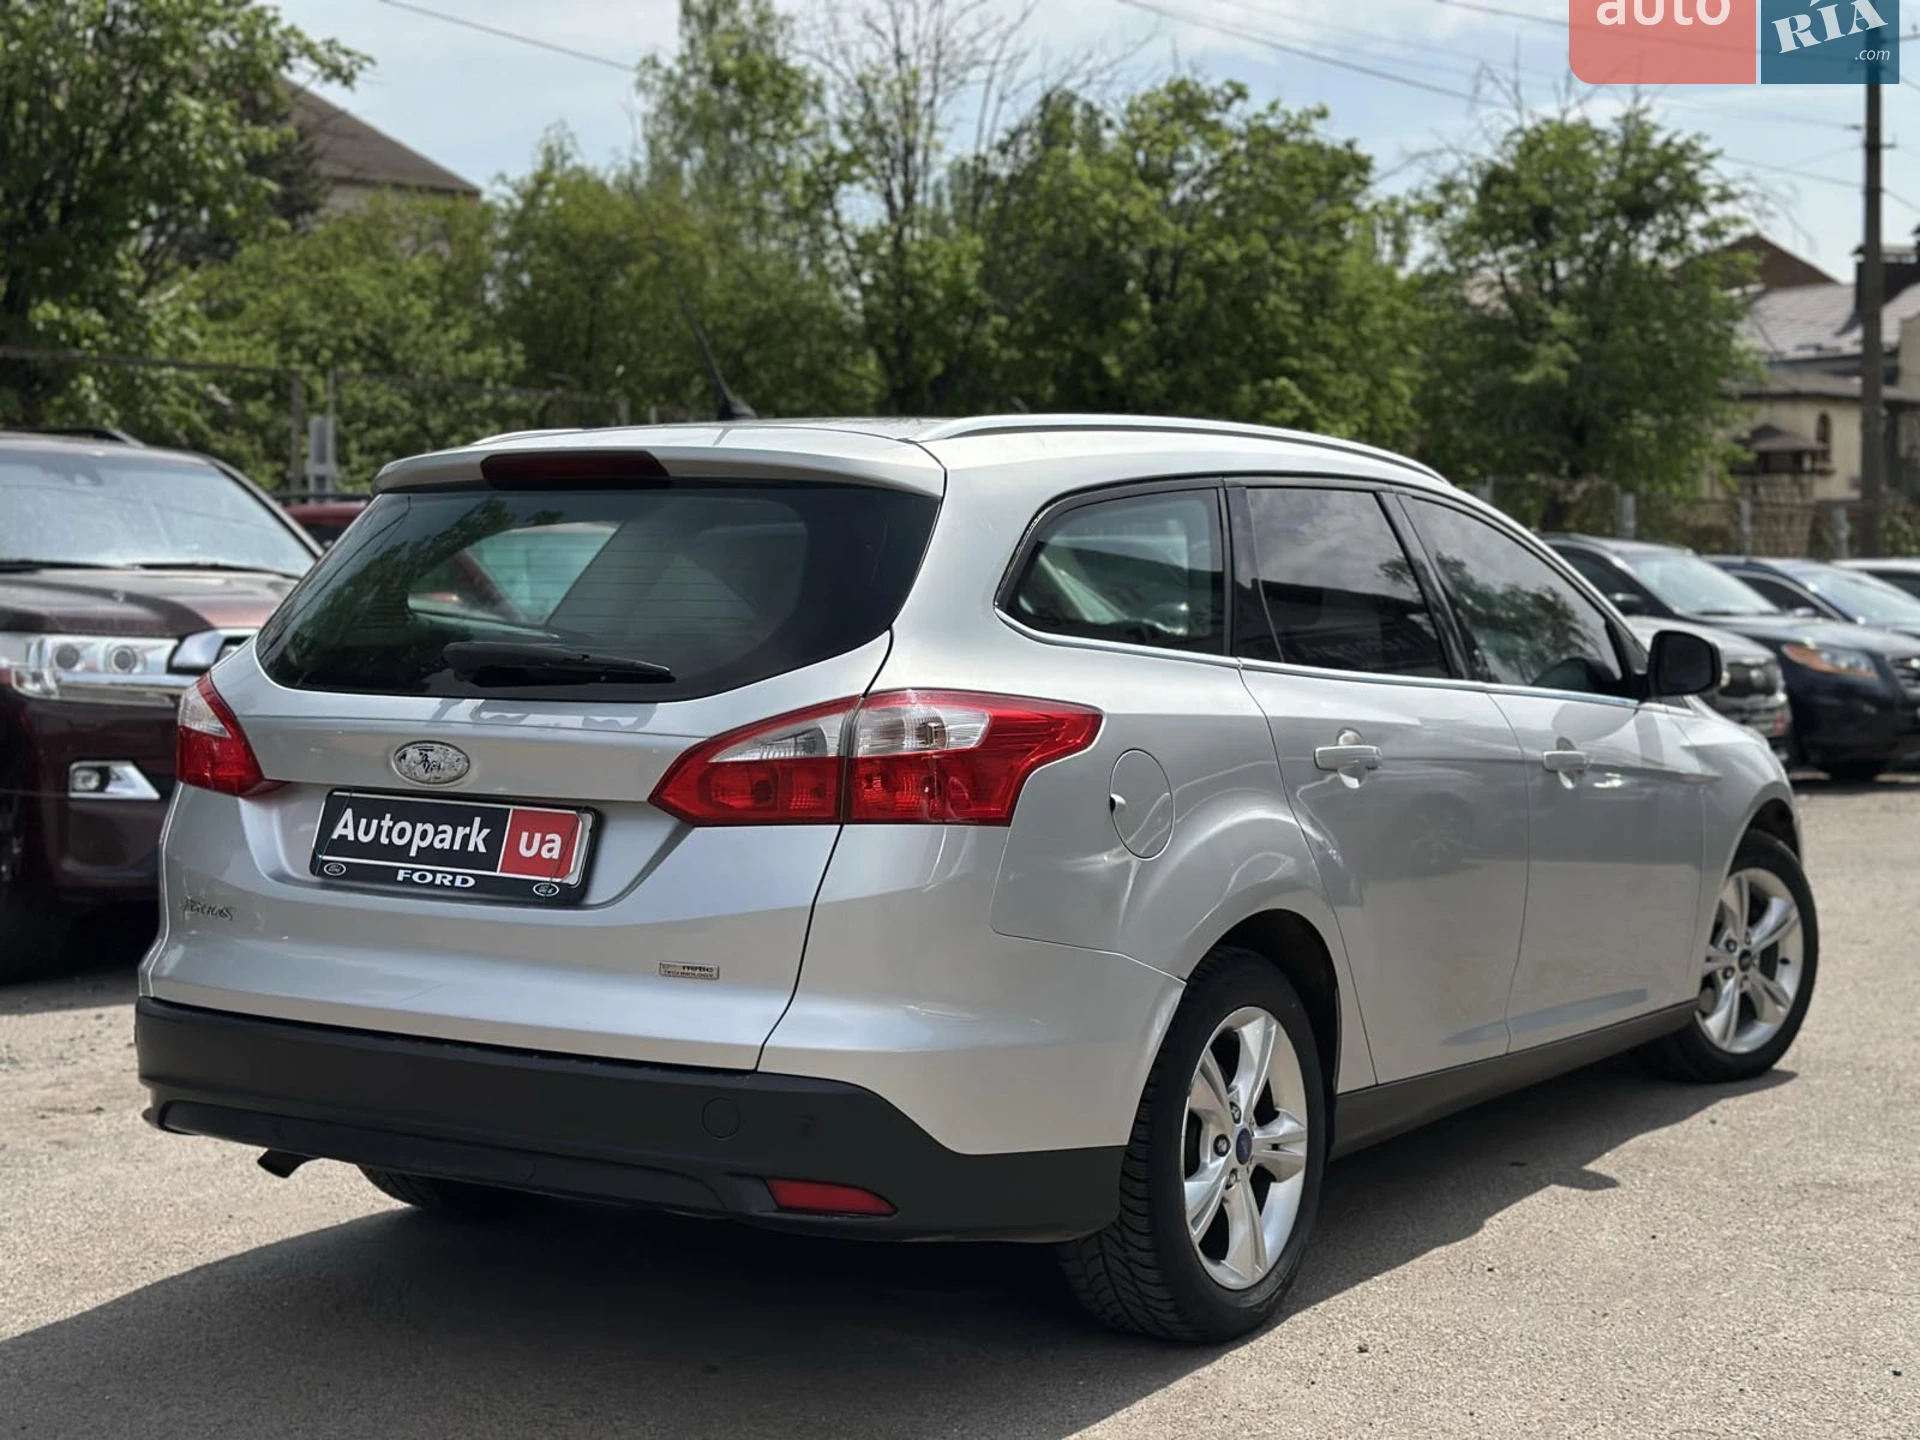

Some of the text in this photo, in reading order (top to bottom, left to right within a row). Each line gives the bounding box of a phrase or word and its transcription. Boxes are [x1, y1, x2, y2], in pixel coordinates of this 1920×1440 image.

[330, 807, 563, 860] Autopark ua
[396, 869, 476, 889] FORD
